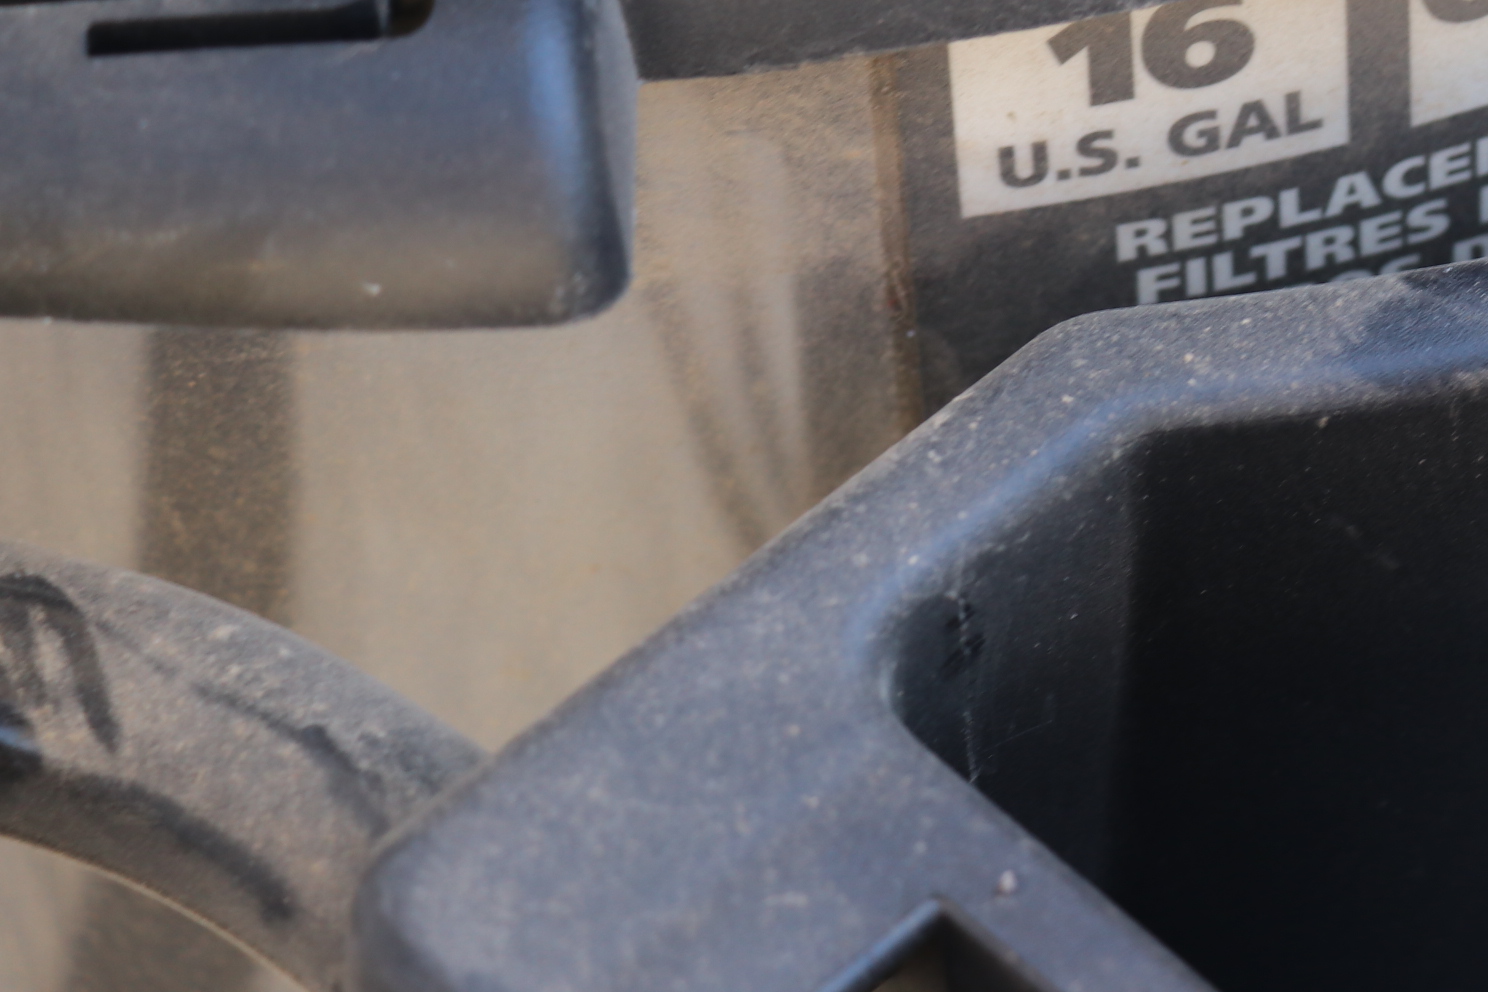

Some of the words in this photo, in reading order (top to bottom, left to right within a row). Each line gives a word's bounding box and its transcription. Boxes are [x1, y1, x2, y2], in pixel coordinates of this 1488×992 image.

[998, 129, 1141, 188] U.S.
[1167, 90, 1324, 157] GAL
[1136, 198, 1450, 305] FILTRES
